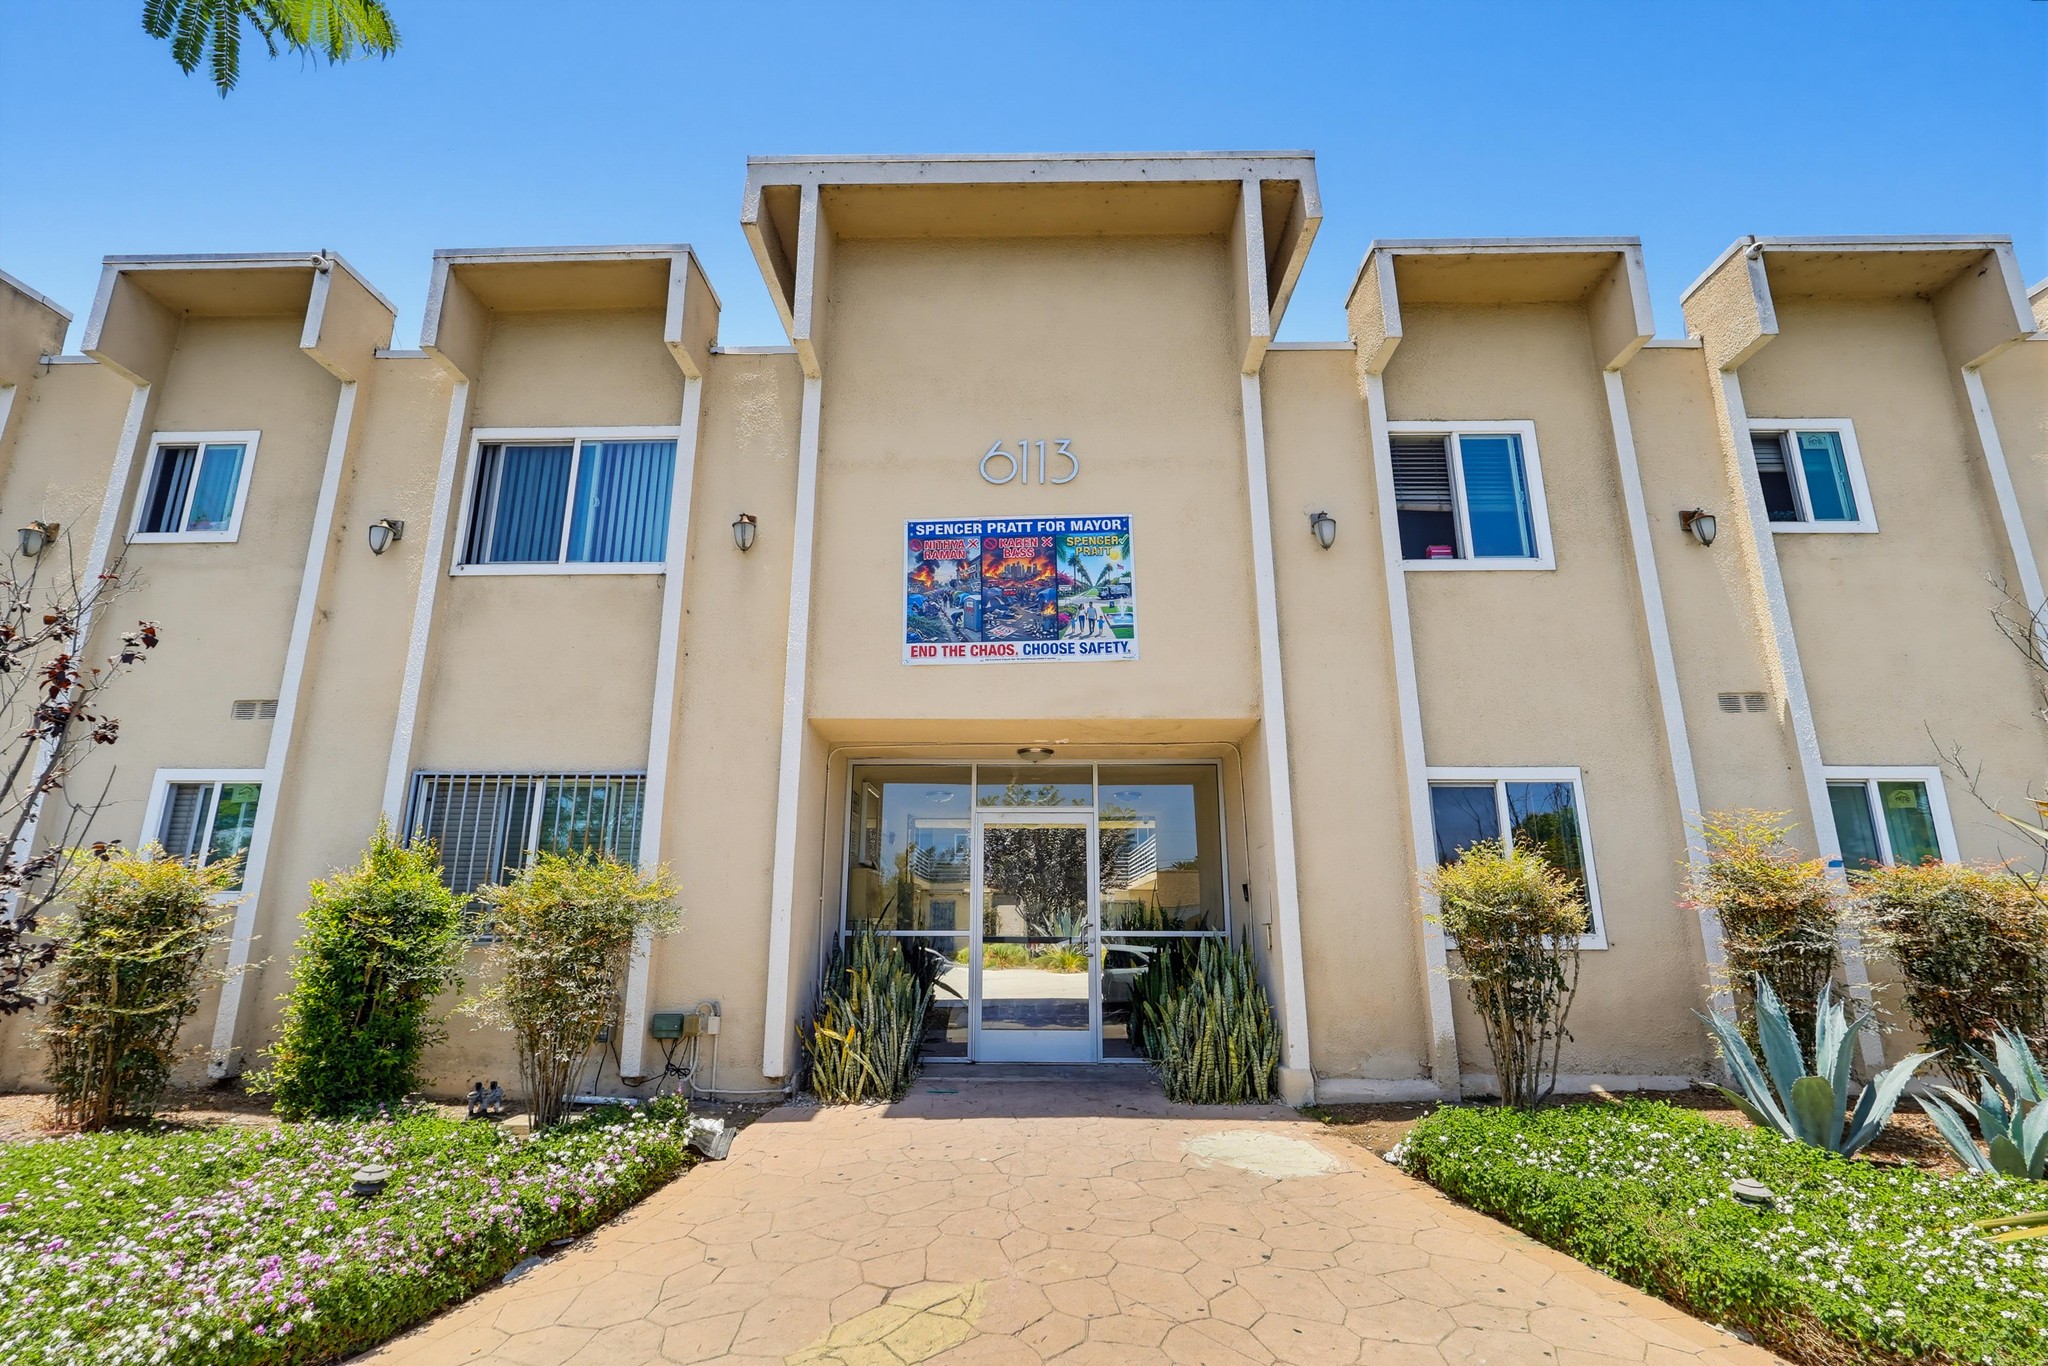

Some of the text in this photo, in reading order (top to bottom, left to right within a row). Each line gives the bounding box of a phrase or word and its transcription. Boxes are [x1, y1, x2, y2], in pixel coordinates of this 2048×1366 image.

[979, 439, 1079, 485] 6113
[916, 519, 1122, 535] SPENCER PRATT FOR MAYOR
[923, 540, 966, 550] NITHYA
[999, 538, 1038, 548] KAREN
[1066, 536, 1119, 546] SPENCER
[923, 550, 967, 560] RAMAN
[1004, 549, 1035, 558] BASS
[1075, 546, 1111, 556] PRATT
[910, 641, 1131, 658] END THE CHAOS. CHOOSE SAFETY.
